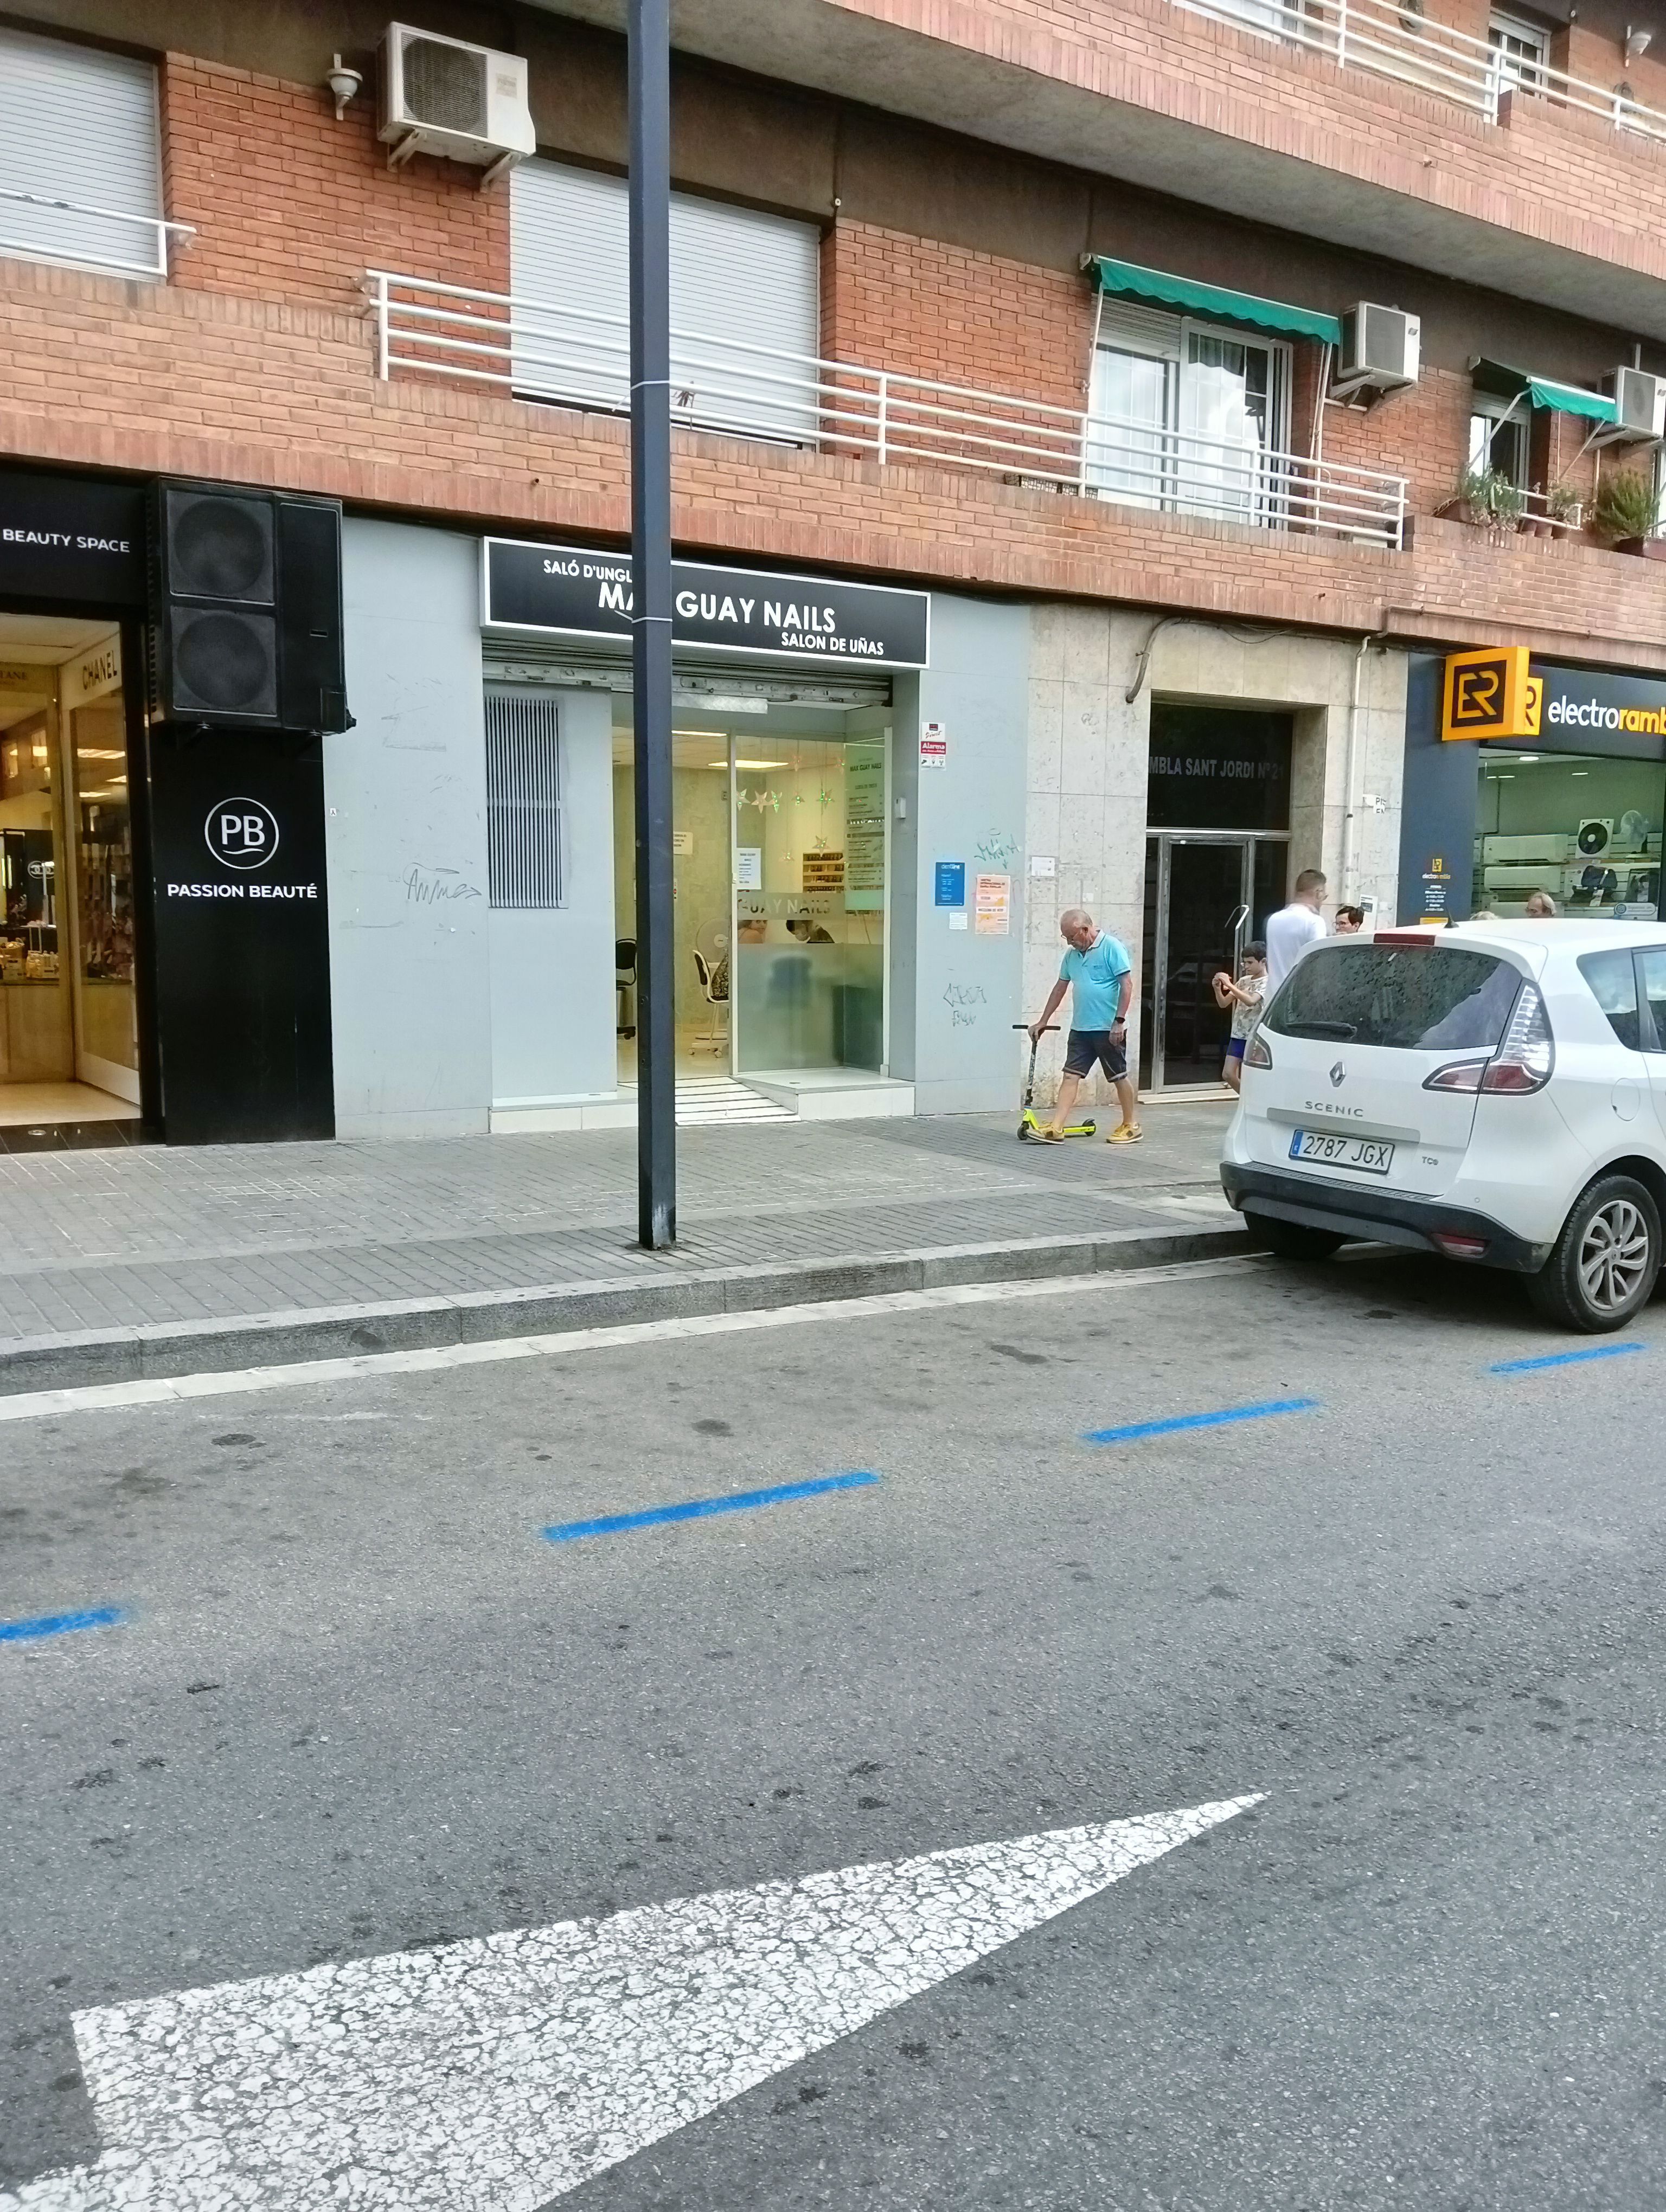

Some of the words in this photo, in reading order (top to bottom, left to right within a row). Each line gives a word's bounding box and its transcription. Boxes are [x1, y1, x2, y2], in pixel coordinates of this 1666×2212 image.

[3, 529, 71, 546] BEAUTY
[76, 536, 130, 552] SPACE
[543, 559, 579, 576] SALÓ
[583, 564, 633, 583] D'UNGL
[676, 591, 755, 623] GUAY
[764, 601, 836, 633] NAILS
[781, 632, 826, 650] SALON
[830, 637, 846, 652] DE
[850, 637, 884, 655] UÑAS
[82, 650, 118, 691] CHANEL
[922, 742, 945, 750] Alarma
[1149, 756, 1182, 775] MBLA
[1186, 758, 1218, 776] SANT
[1220, 760, 1254, 779] JORDI
[221, 815, 265, 846] PB
[168, 884, 244, 897] PASSION
[249, 883, 318, 898] BEAUTÉ
[787, 899, 830, 914] NAILS
[1305, 1101, 1364, 1117] SCENIC
[1303, 1136, 1347, 1159] 2787
[1351, 1143, 1388, 1167] JGX
